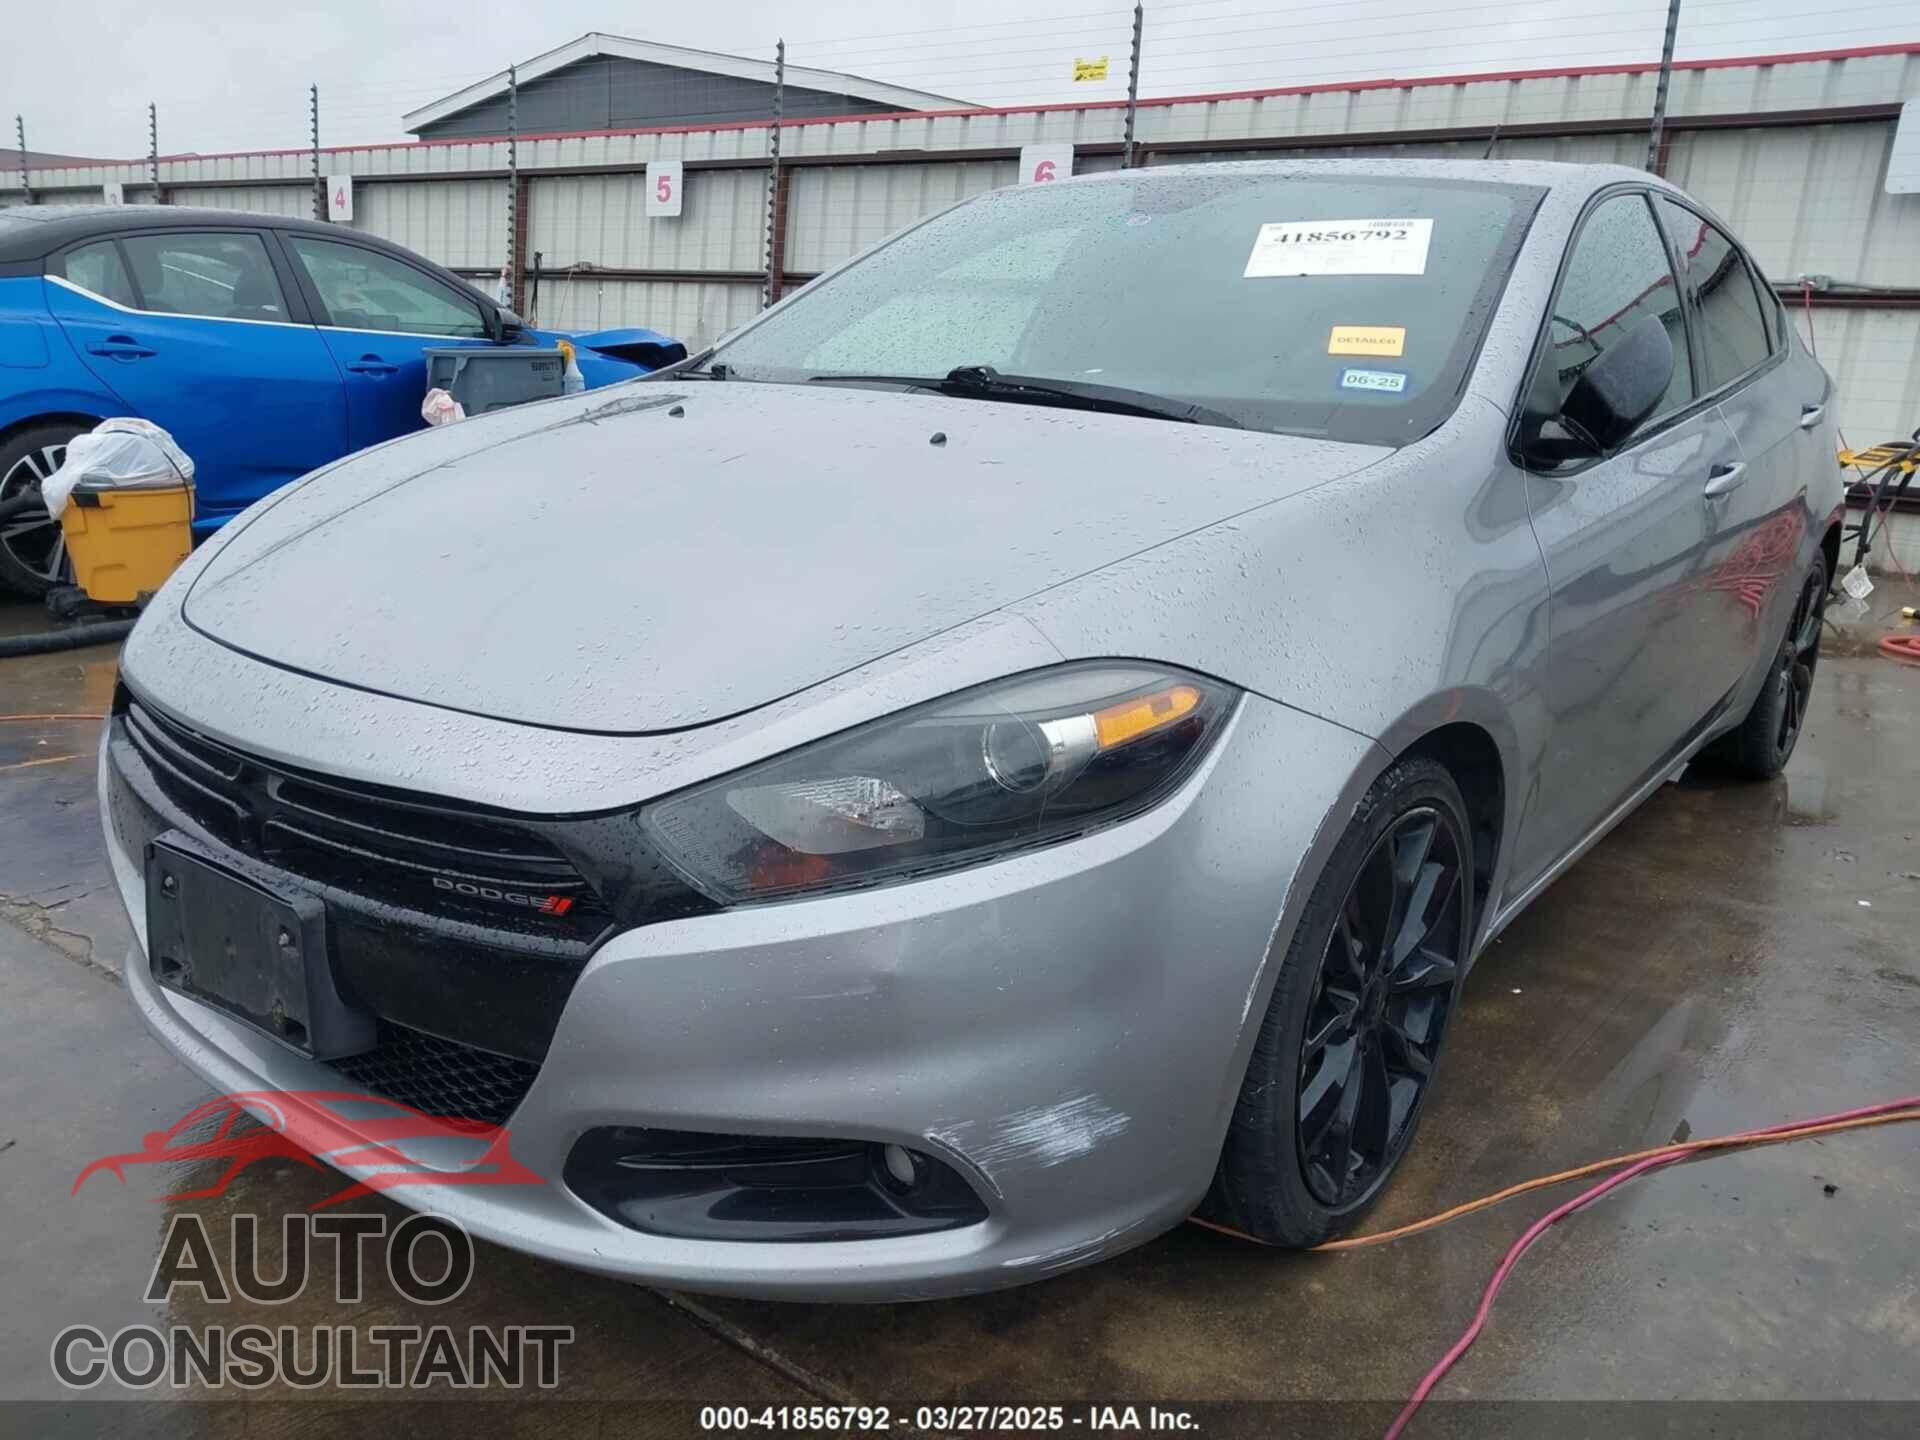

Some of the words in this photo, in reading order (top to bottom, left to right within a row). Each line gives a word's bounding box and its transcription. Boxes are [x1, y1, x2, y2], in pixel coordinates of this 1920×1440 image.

[1035, 160, 1056, 182] 6
[335, 186, 346, 209] 4
[656, 175, 671, 203] 5
[1273, 229, 1408, 244] 41856792
[1346, 375, 1400, 388] 06-25
[432, 877, 554, 910] DODGE
